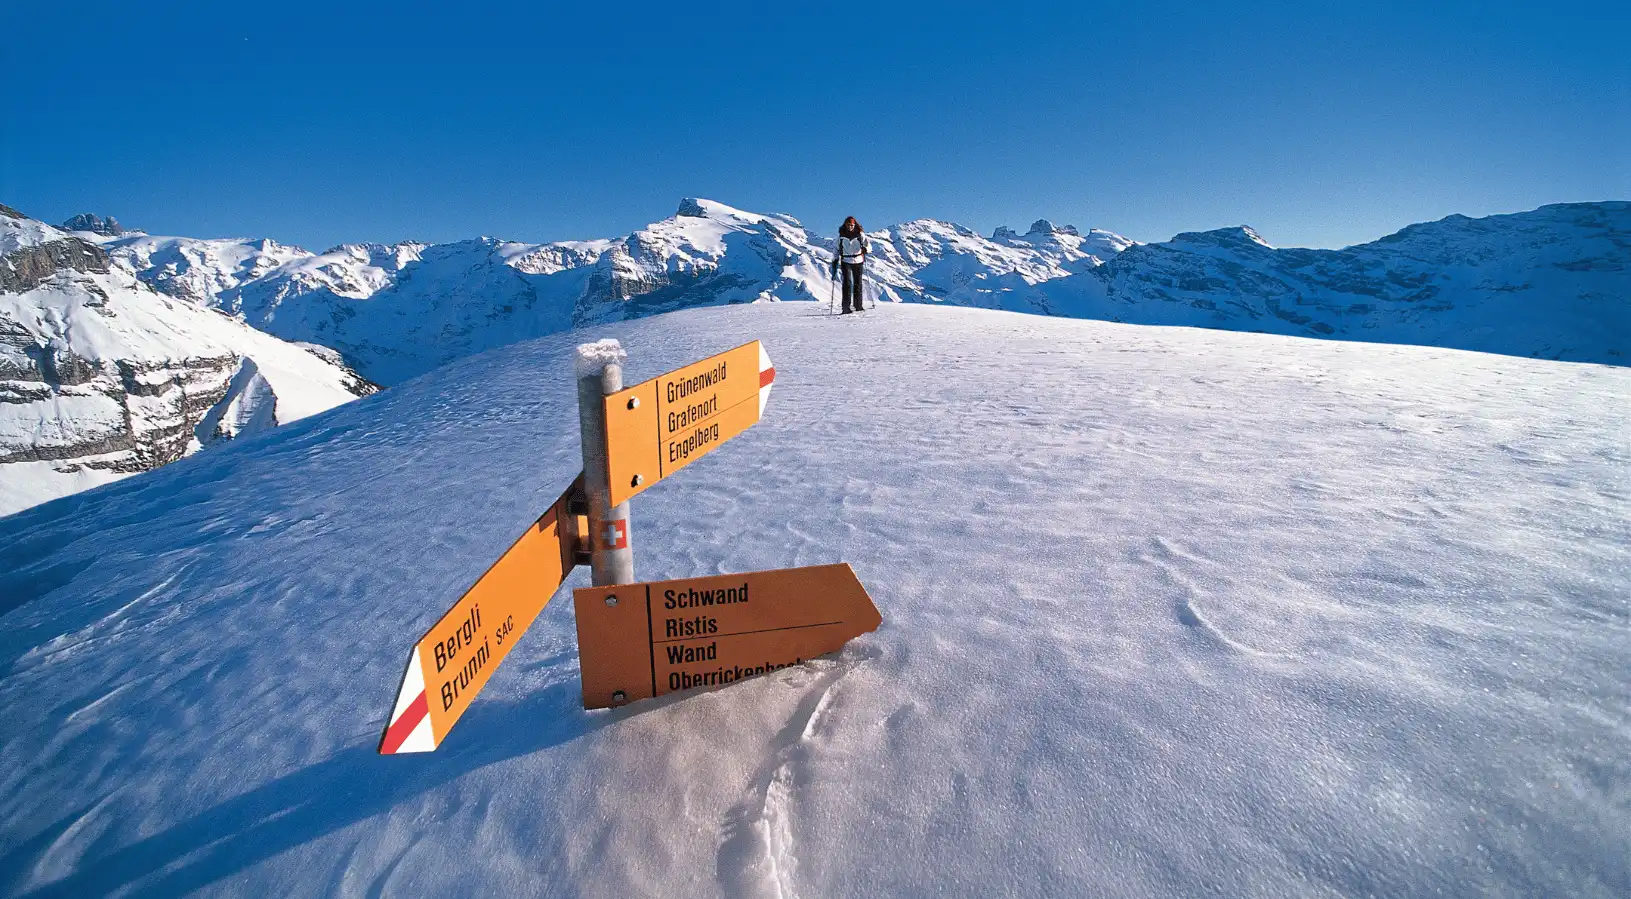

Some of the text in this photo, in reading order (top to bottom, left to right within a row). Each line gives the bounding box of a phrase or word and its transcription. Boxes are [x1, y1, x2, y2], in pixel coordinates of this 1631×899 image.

[667, 361, 727, 403] Grünenwald
[668, 393, 717, 433] Grafenort
[669, 423, 719, 463] Engelberg
[664, 583, 749, 609] Schwand
[434, 603, 481, 673] Bergli
[666, 616, 718, 637] Ristis
[441, 615, 514, 712] Brunni SAC
[667, 642, 717, 664] Wand
